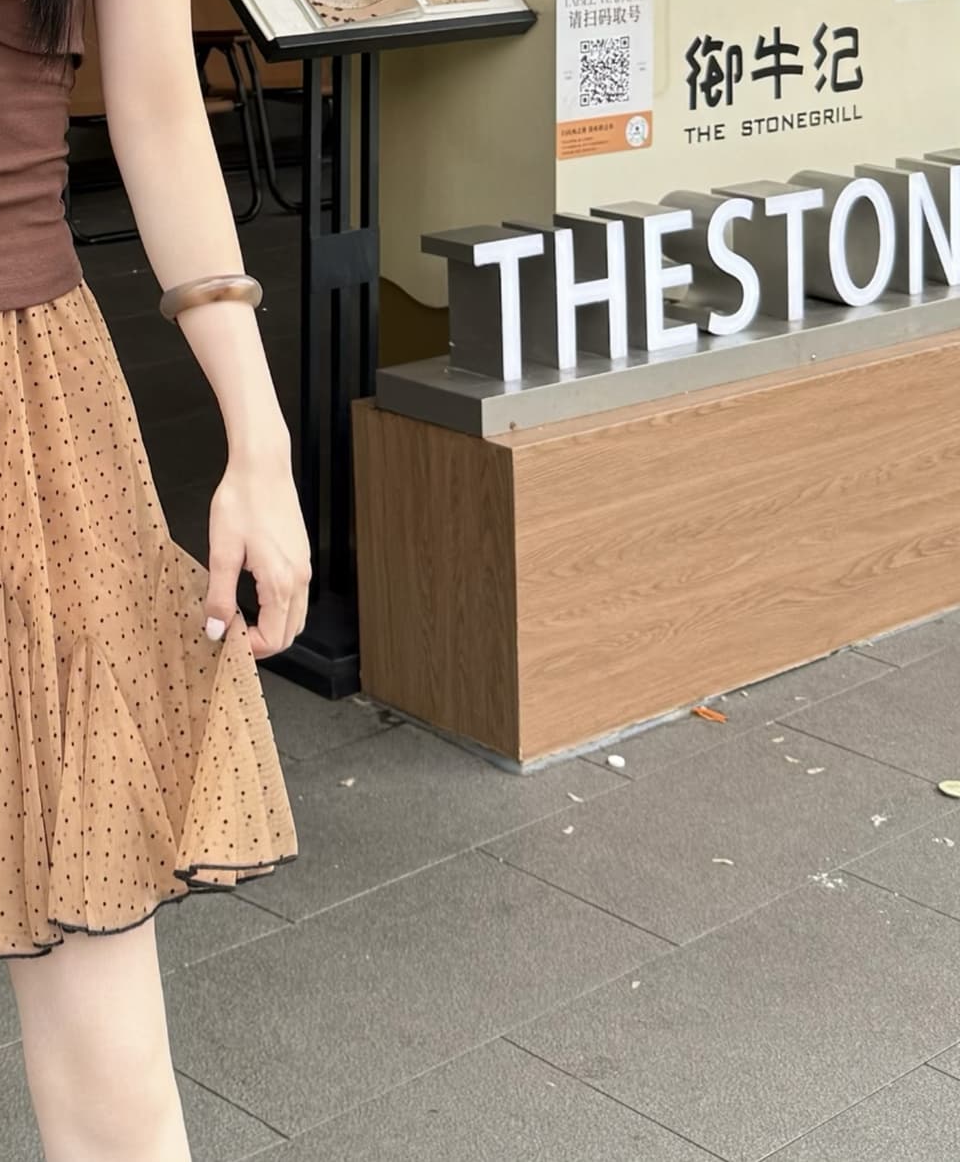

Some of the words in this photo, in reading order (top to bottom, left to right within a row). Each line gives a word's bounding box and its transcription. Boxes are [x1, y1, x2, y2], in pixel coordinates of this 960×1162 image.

[569, 4, 641, 29] 请扫码取号
[683, 22, 864, 111] 御牛记
[683, 124, 726, 145] THE
[740, 104, 864, 138] STONEGRILL
